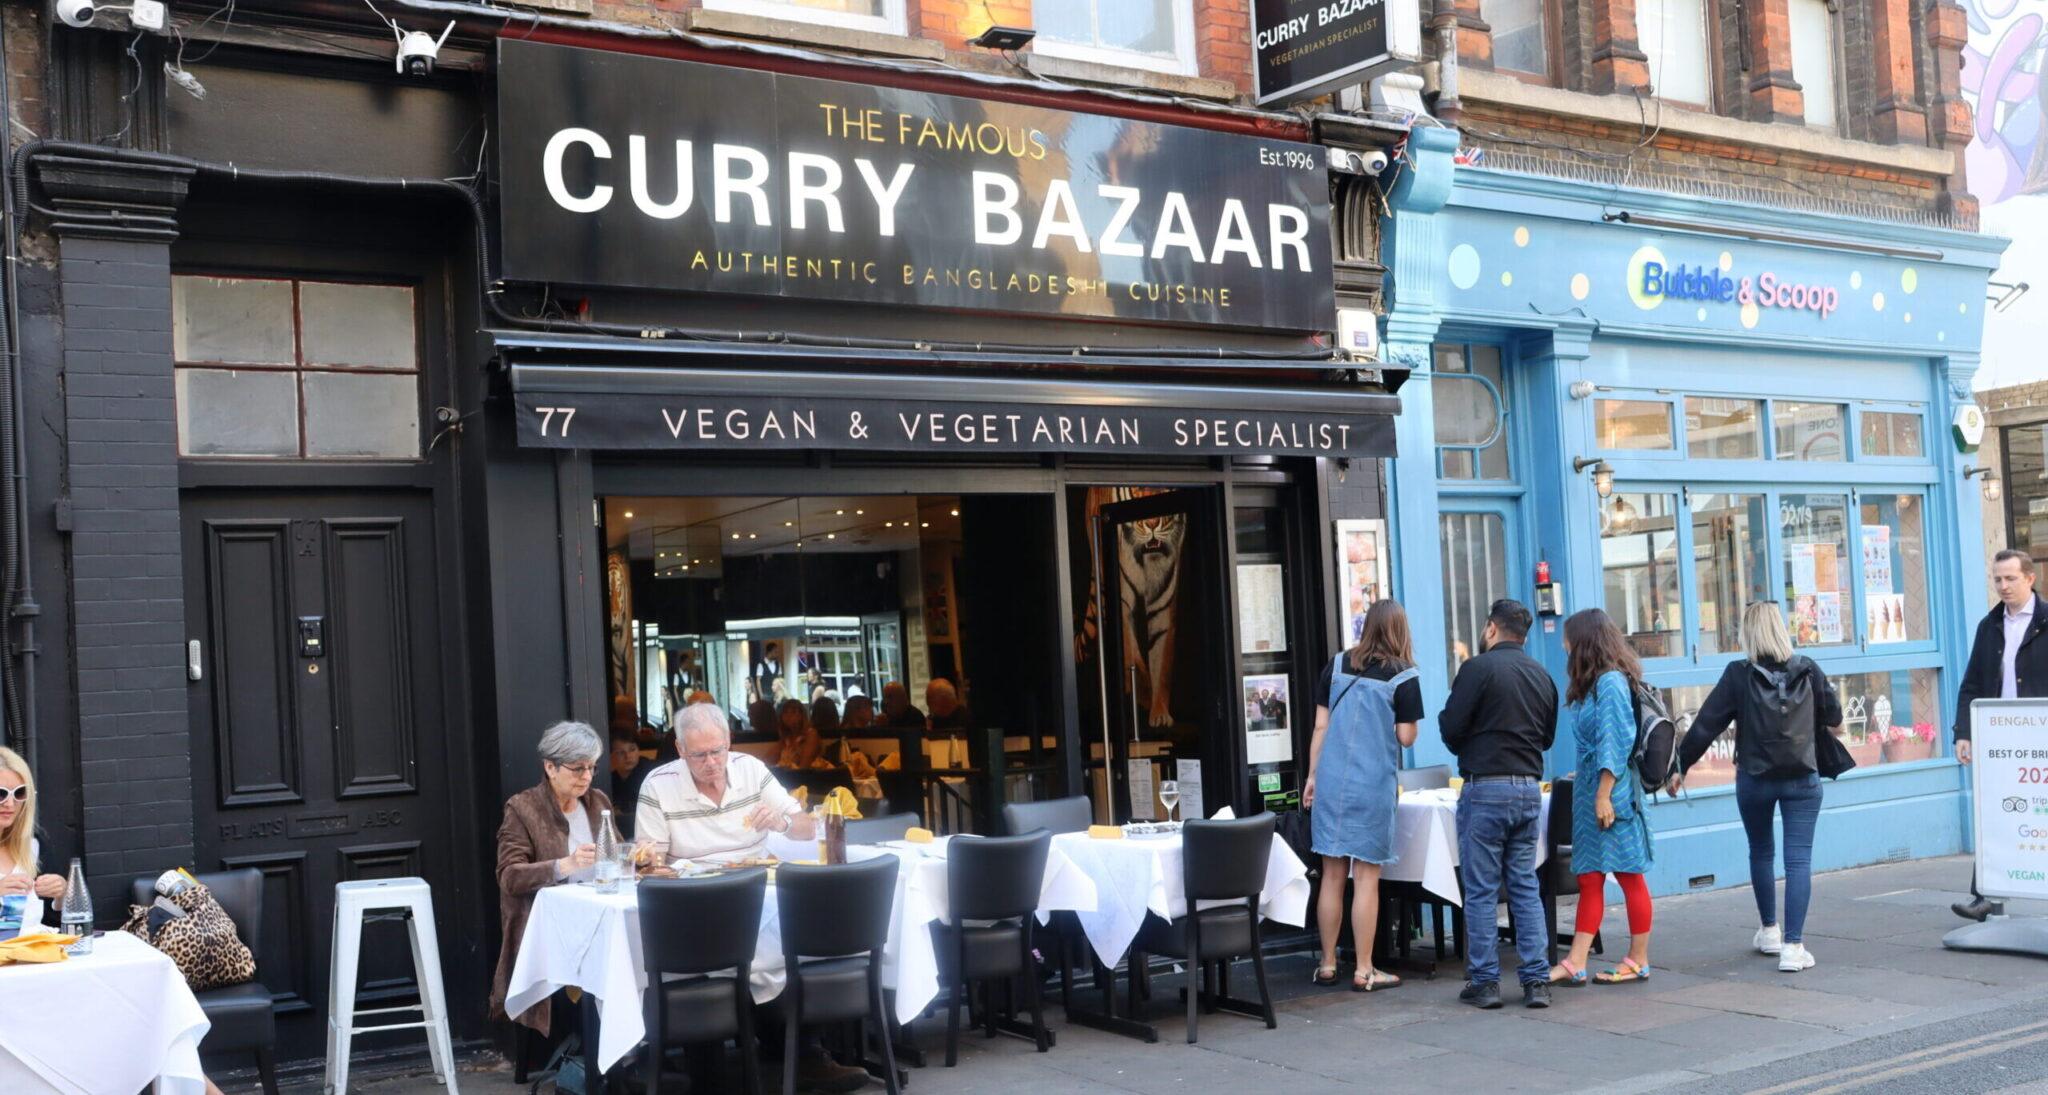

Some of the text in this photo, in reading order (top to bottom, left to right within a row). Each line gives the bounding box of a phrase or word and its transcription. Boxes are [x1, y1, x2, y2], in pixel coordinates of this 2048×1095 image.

[1257, 13, 1310, 50] CURRY
[1270, 18, 1378, 67] VEGETARIAN SPECIALIST
[820, 103, 1048, 160] THE FAMOUS
[1259, 147, 1315, 170] Est.1996
[542, 126, 1313, 273] CURRY BAZAAR
[690, 249, 1232, 308] AUTHENTIC BANGLADESHI CUISINE
[1643, 261, 1839, 320] Bubble & Scoop
[535, 407, 1351, 451] 77 VEGAN & VEGETARIAN SPECIALIST
[1989, 716, 2036, 727] BENGAL
[1988, 749, 2012, 759] BEST
[2015, 749, 2029, 759] OF
[2007, 870, 2045, 881] VEGAN
